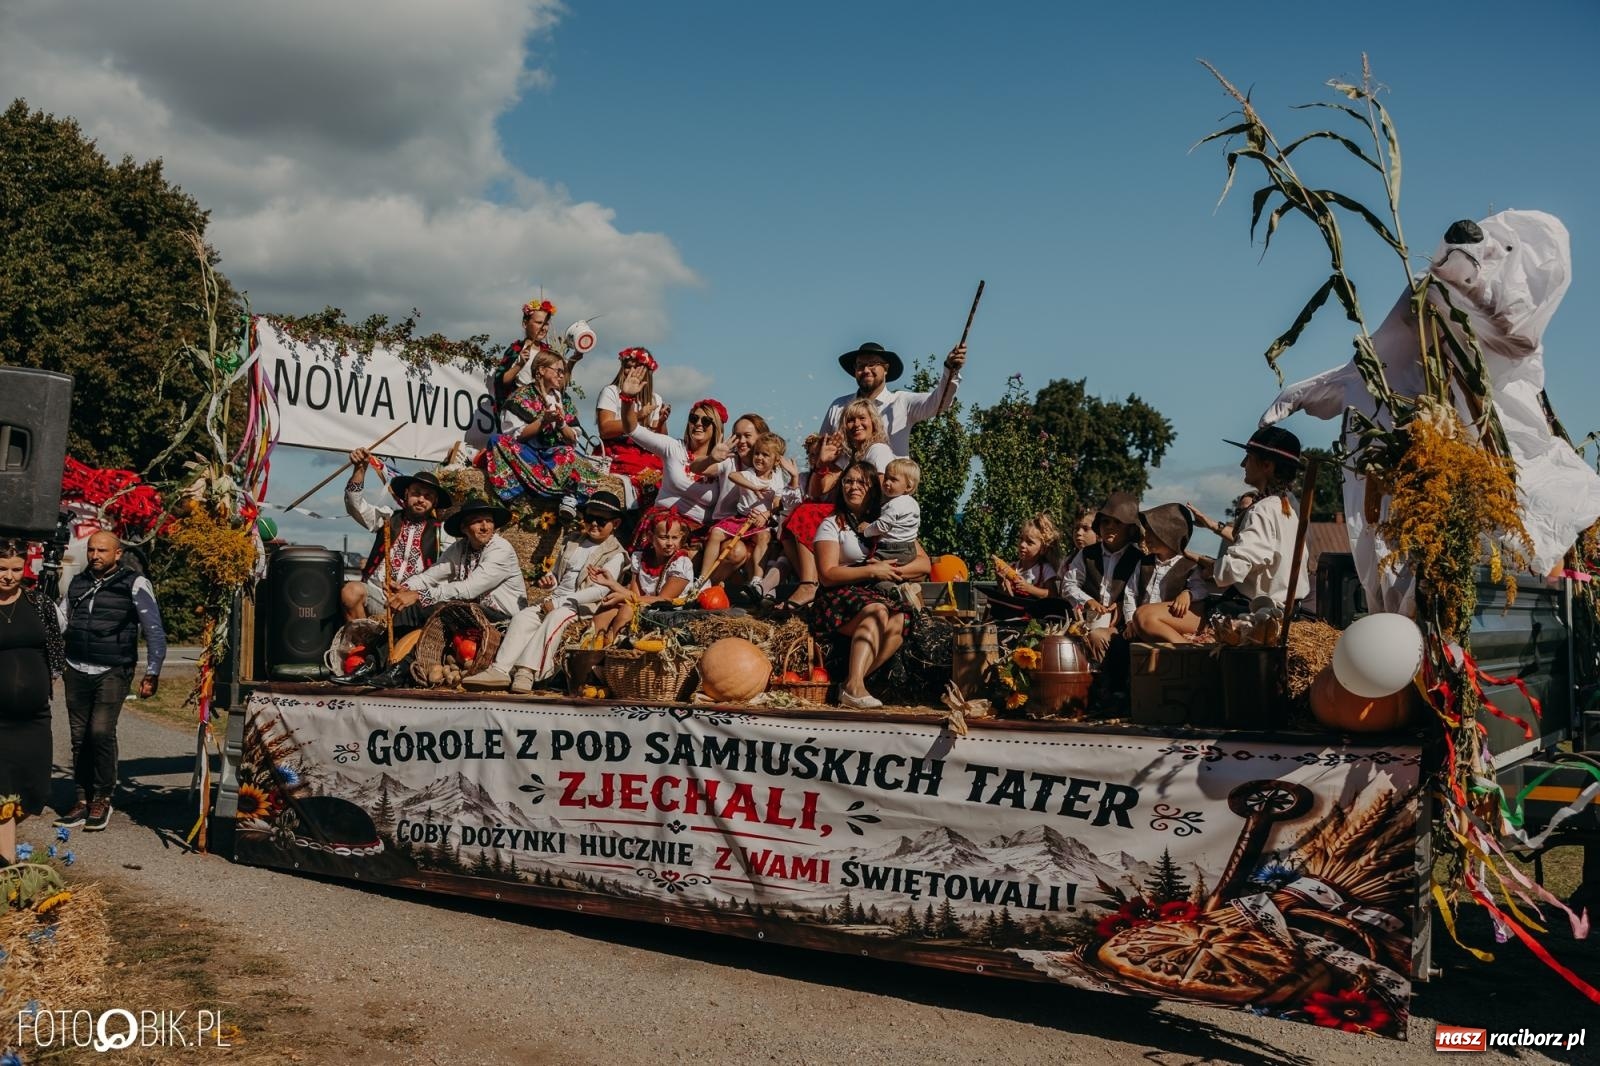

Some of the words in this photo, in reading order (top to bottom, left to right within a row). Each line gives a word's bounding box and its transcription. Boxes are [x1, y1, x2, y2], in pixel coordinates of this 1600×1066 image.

[275, 358, 395, 420] NOWA
[407, 381, 501, 434] WIOS
[367, 726, 505, 766] GÓROLE
[516, 728, 539, 760] Z
[551, 730, 632, 762] POD
[645, 732, 946, 796] SAMIUŚKICH
[964, 763, 1140, 829] TATER
[558, 771, 833, 838] ZJECHALI,
[396, 820, 452, 843] COBY
[461, 823, 566, 854] DOŻYNKI
[580, 834, 694, 866] HUCZNIE
[715, 846, 733, 871] Z
[743, 849, 831, 884] WAMI
[840, 856, 1078, 912] ŚWIĘTOWALI!
